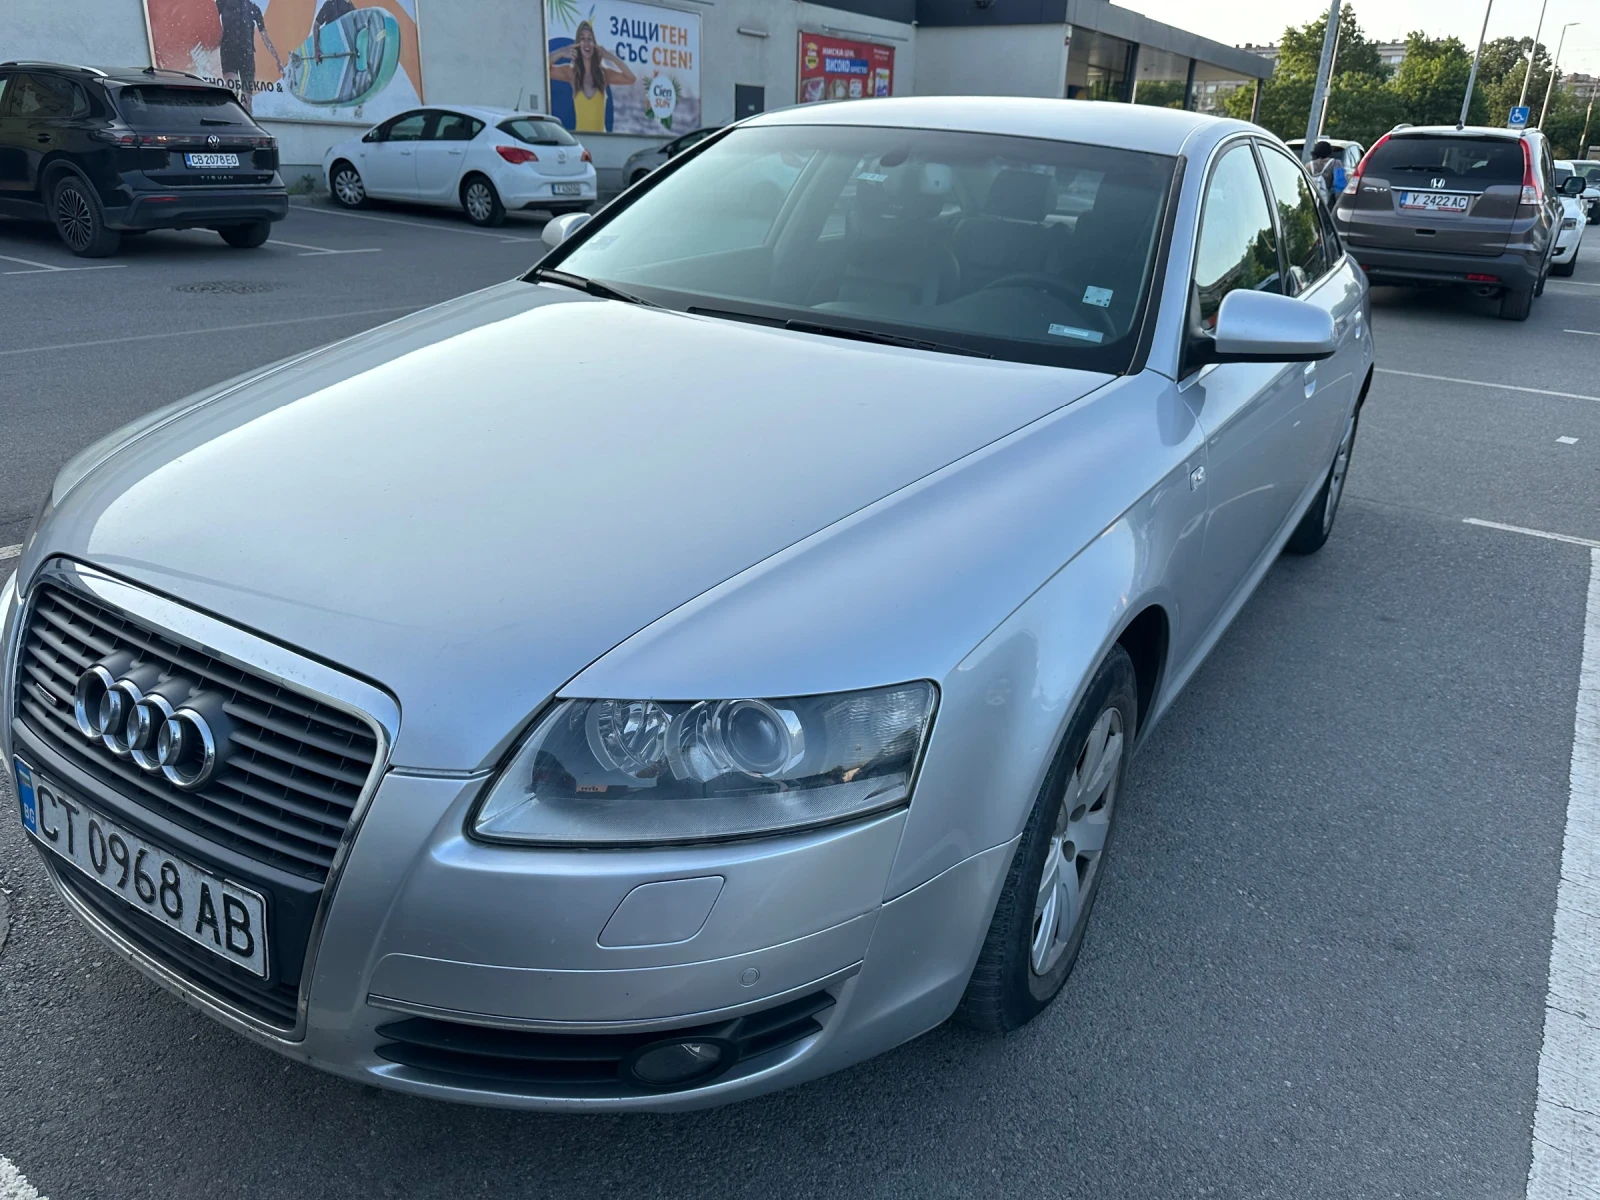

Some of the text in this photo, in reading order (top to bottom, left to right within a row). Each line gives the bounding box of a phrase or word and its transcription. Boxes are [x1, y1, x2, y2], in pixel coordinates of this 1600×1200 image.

[610, 16, 687, 46] ЗАЩИТЕН
[615, 41, 692, 70] СЪС CIEN!
[227, 80, 274, 92] ОБЛЕКЛО
[276, 82, 283, 92] &
[205, 154, 225, 165] 2078
[1423, 194, 1450, 207] 2422
[1451, 196, 1466, 208] AC
[23, 803, 36, 824] BG
[37, 784, 255, 958] CT 0968 AB
